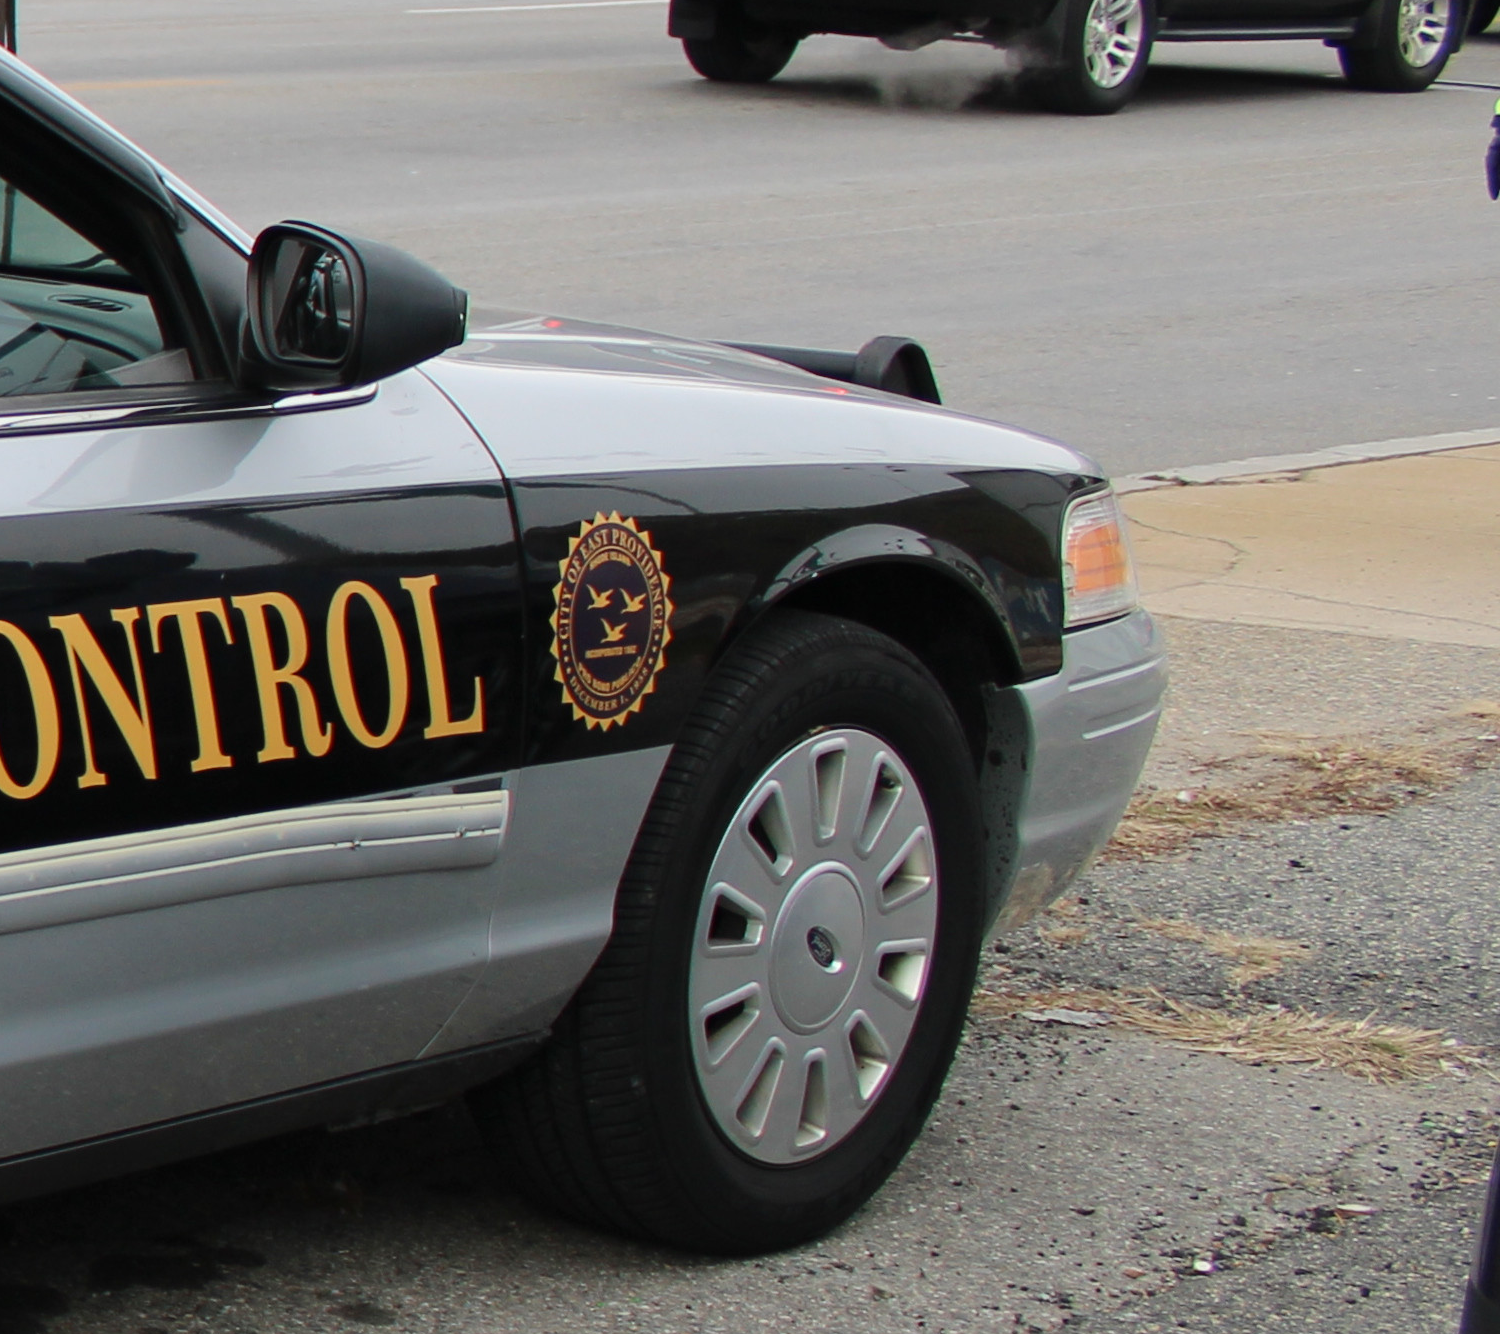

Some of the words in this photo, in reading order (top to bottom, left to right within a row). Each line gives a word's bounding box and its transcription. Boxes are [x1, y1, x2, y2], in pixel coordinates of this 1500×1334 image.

[559, 588, 573, 640] CITY
[566, 554, 582, 584] OF
[579, 528, 610, 562] EAST
[611, 527, 664, 630] PROVIDENCE
[569, 675, 618, 711] DECEMBER
